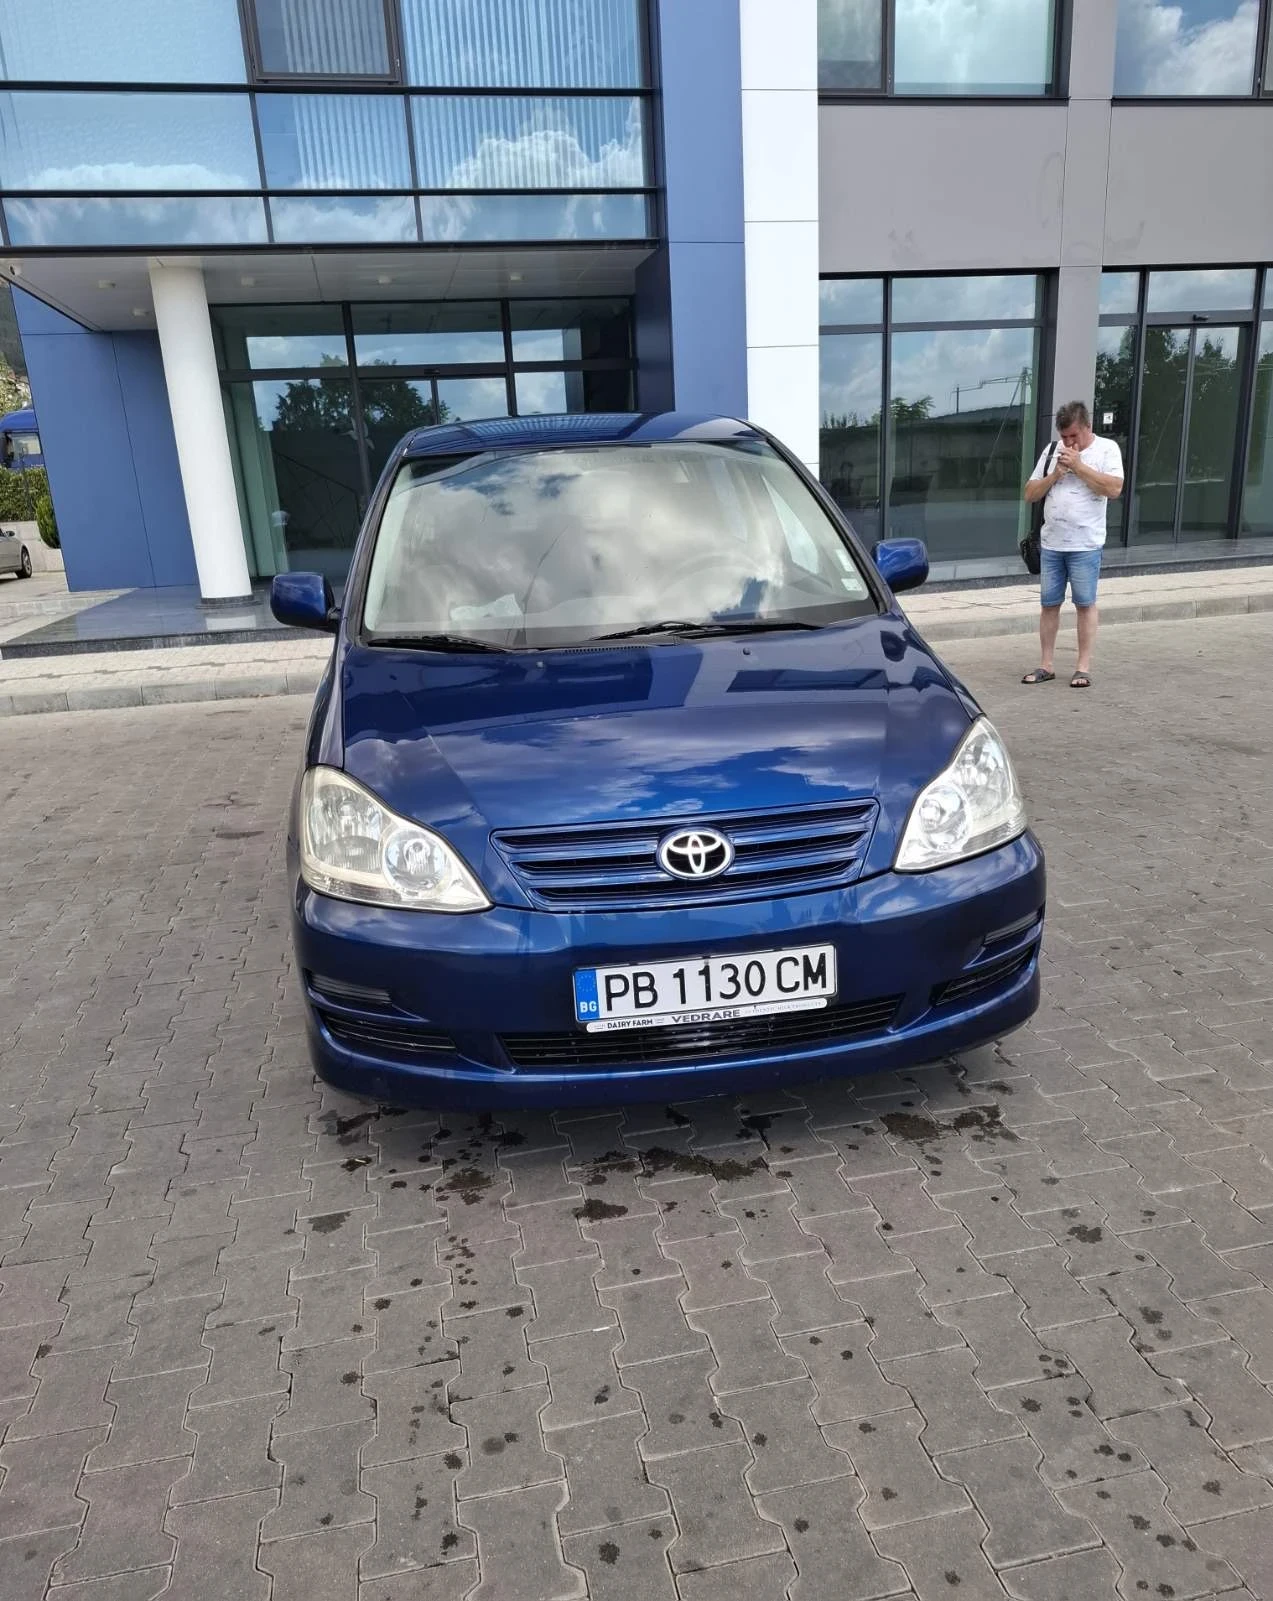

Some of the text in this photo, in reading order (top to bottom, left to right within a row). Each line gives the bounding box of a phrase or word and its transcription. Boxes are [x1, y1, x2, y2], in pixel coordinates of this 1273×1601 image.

[604, 952, 827, 1012] PB 1130 CM
[579, 1001, 598, 1013] BG
[671, 1009, 741, 1023] VEDRARE
[607, 1019, 653, 1029] DAIRY FARM
